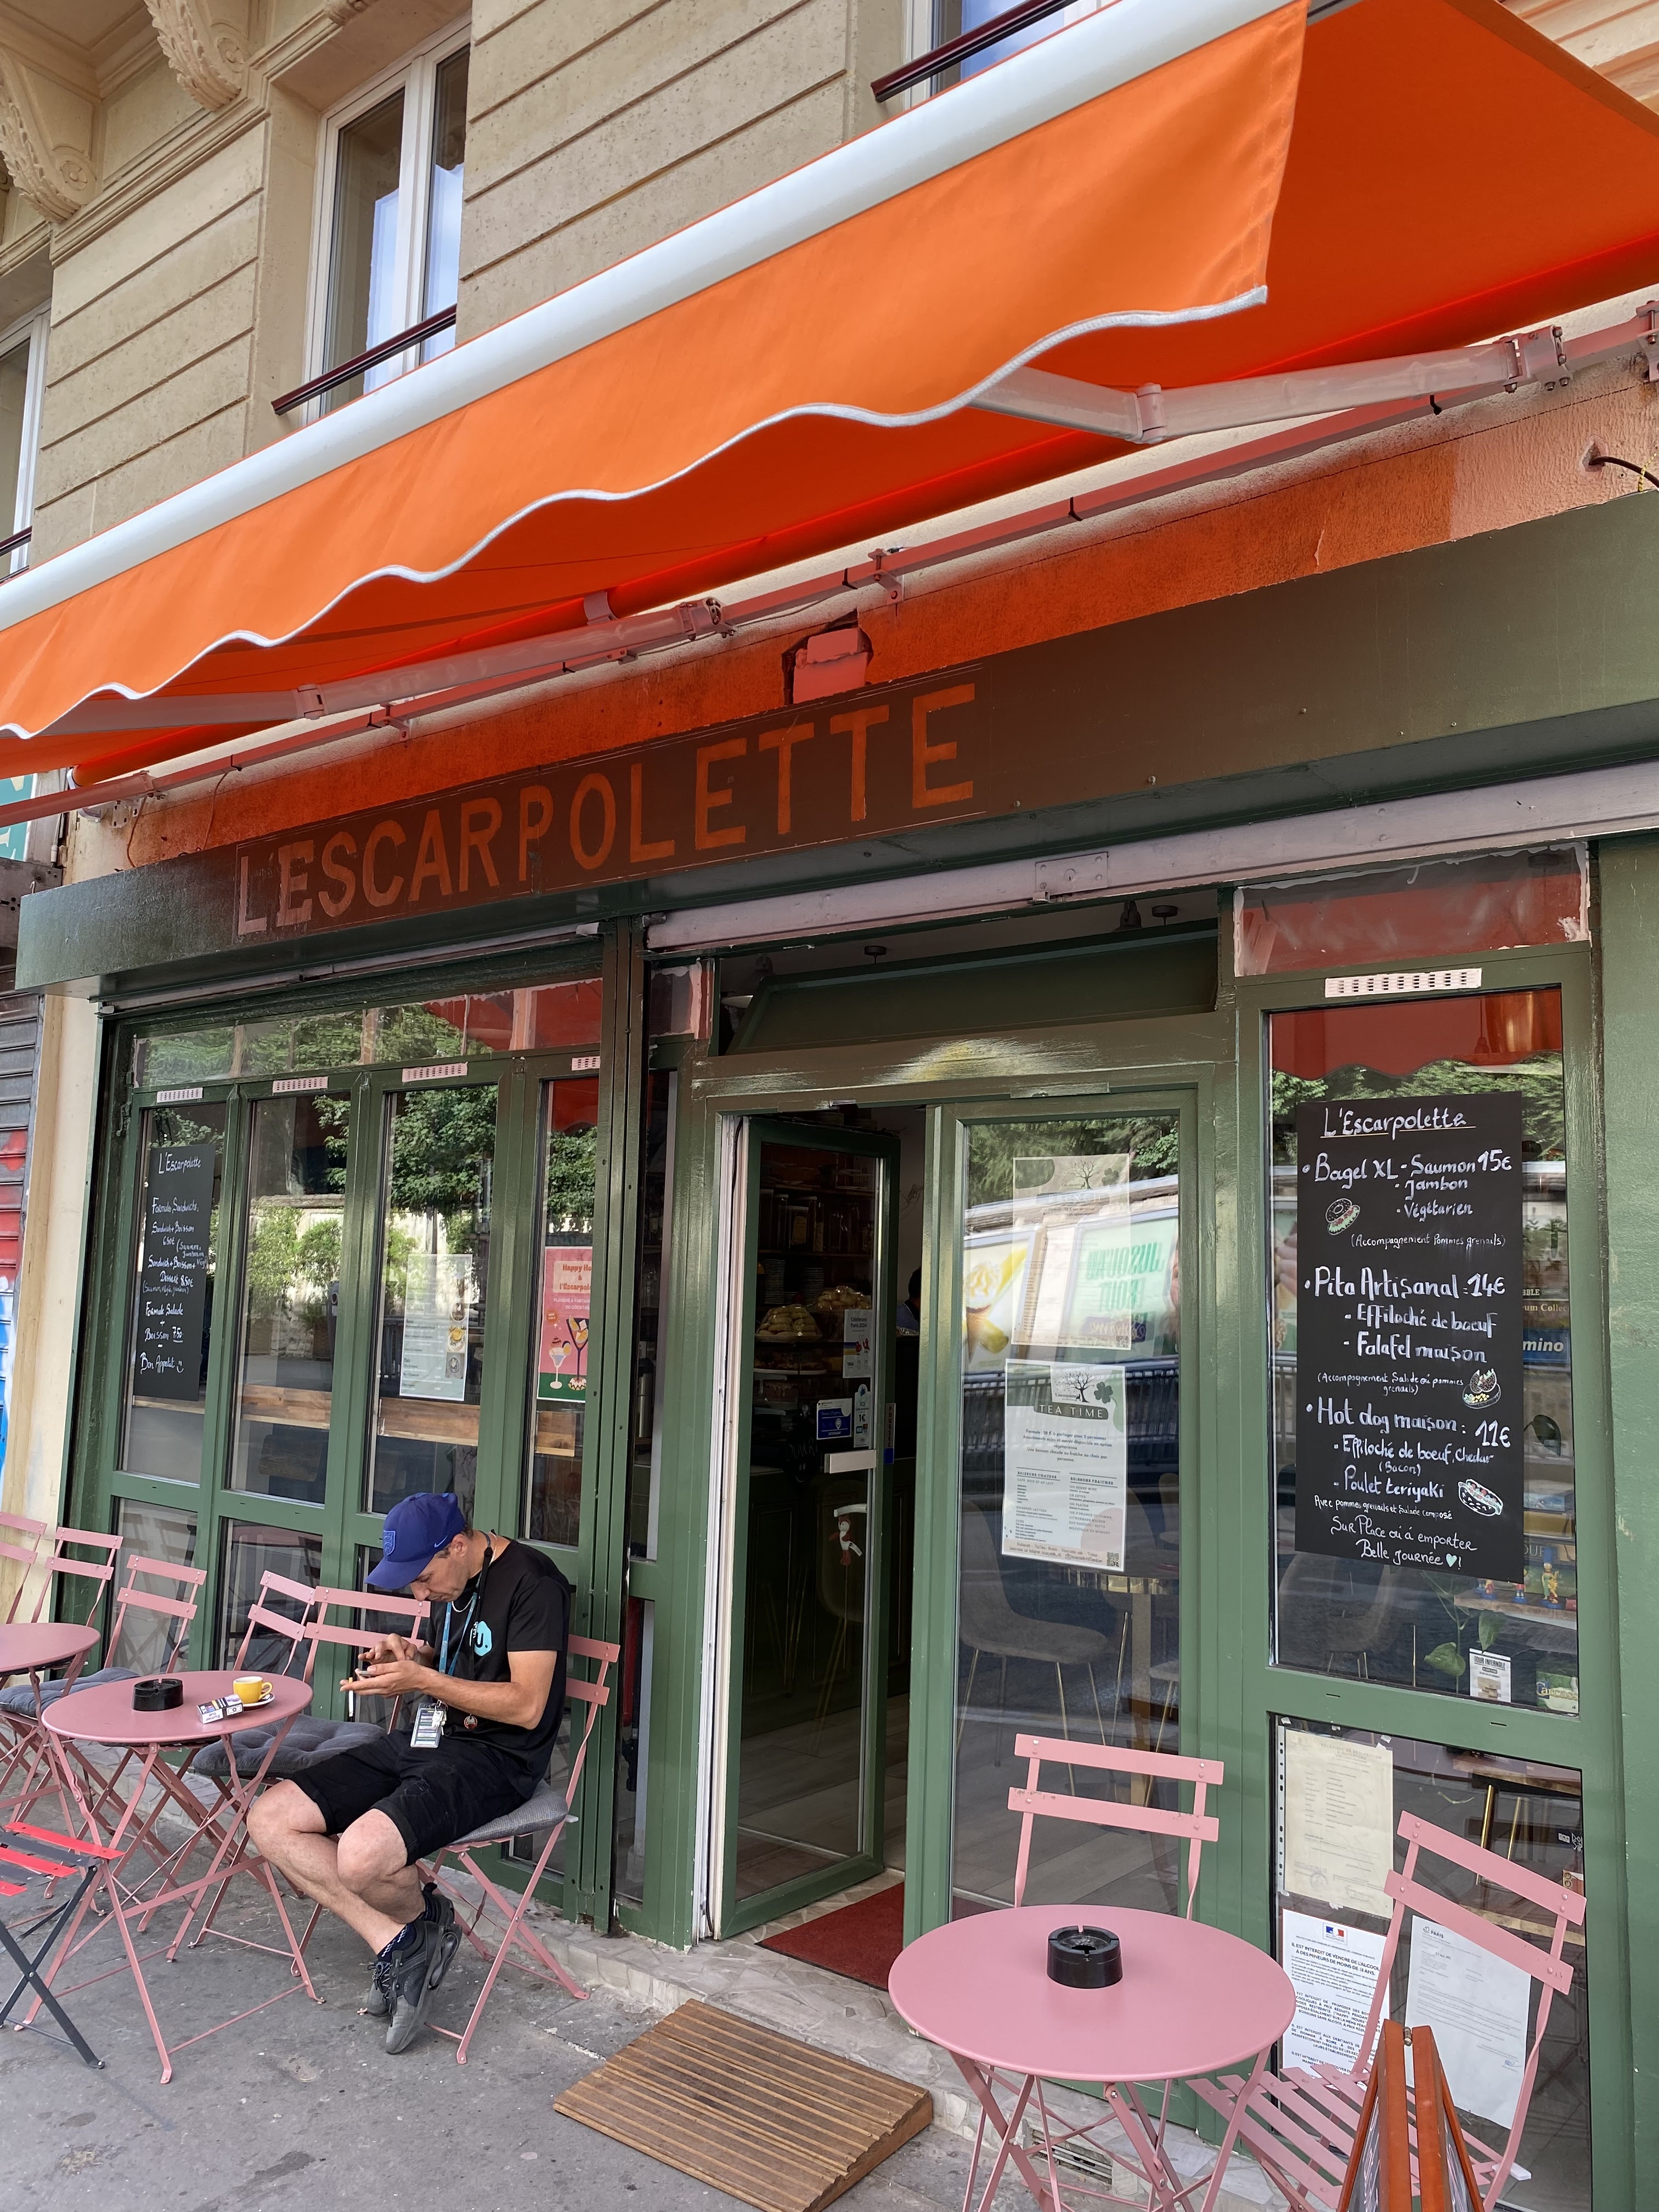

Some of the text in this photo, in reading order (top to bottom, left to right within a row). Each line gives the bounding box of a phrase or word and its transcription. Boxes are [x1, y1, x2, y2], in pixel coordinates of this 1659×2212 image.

[1324, 1107, 1466, 1141] L'Escarpolette
[1314, 1148, 1513, 1189] Bagel XL Saumon 15€
[562, 1264, 582, 1272] Happy
[1314, 1266, 1506, 1301] Pita Artisanal 14€
[1431, 1311, 1448, 1329] de
[1451, 1311, 1498, 1338] boeuf
[1357, 1330, 1487, 1363] Falafel maison
[1039, 1404, 1103, 1418] TEA TIME
[1317, 1396, 1511, 1448] Hot dog maison 11€
[1398, 1441, 1414, 1460] de
[1344, 1464, 1382, 1495] Poulet
[1379, 1462, 1422, 1477] (Bacon)
[1314, 1495, 1333, 1508] Avec
[1355, 1538, 1390, 1560] Belle
[1431, 1930, 1444, 1938] PARIS
[1305, 1946, 1325, 1955] INTERDIT
[1333, 1954, 1351, 1963] VENDRE
[1358, 1961, 1380, 1971] L'ALCOOL
[1309, 1953, 1329, 1962] MINEURS
